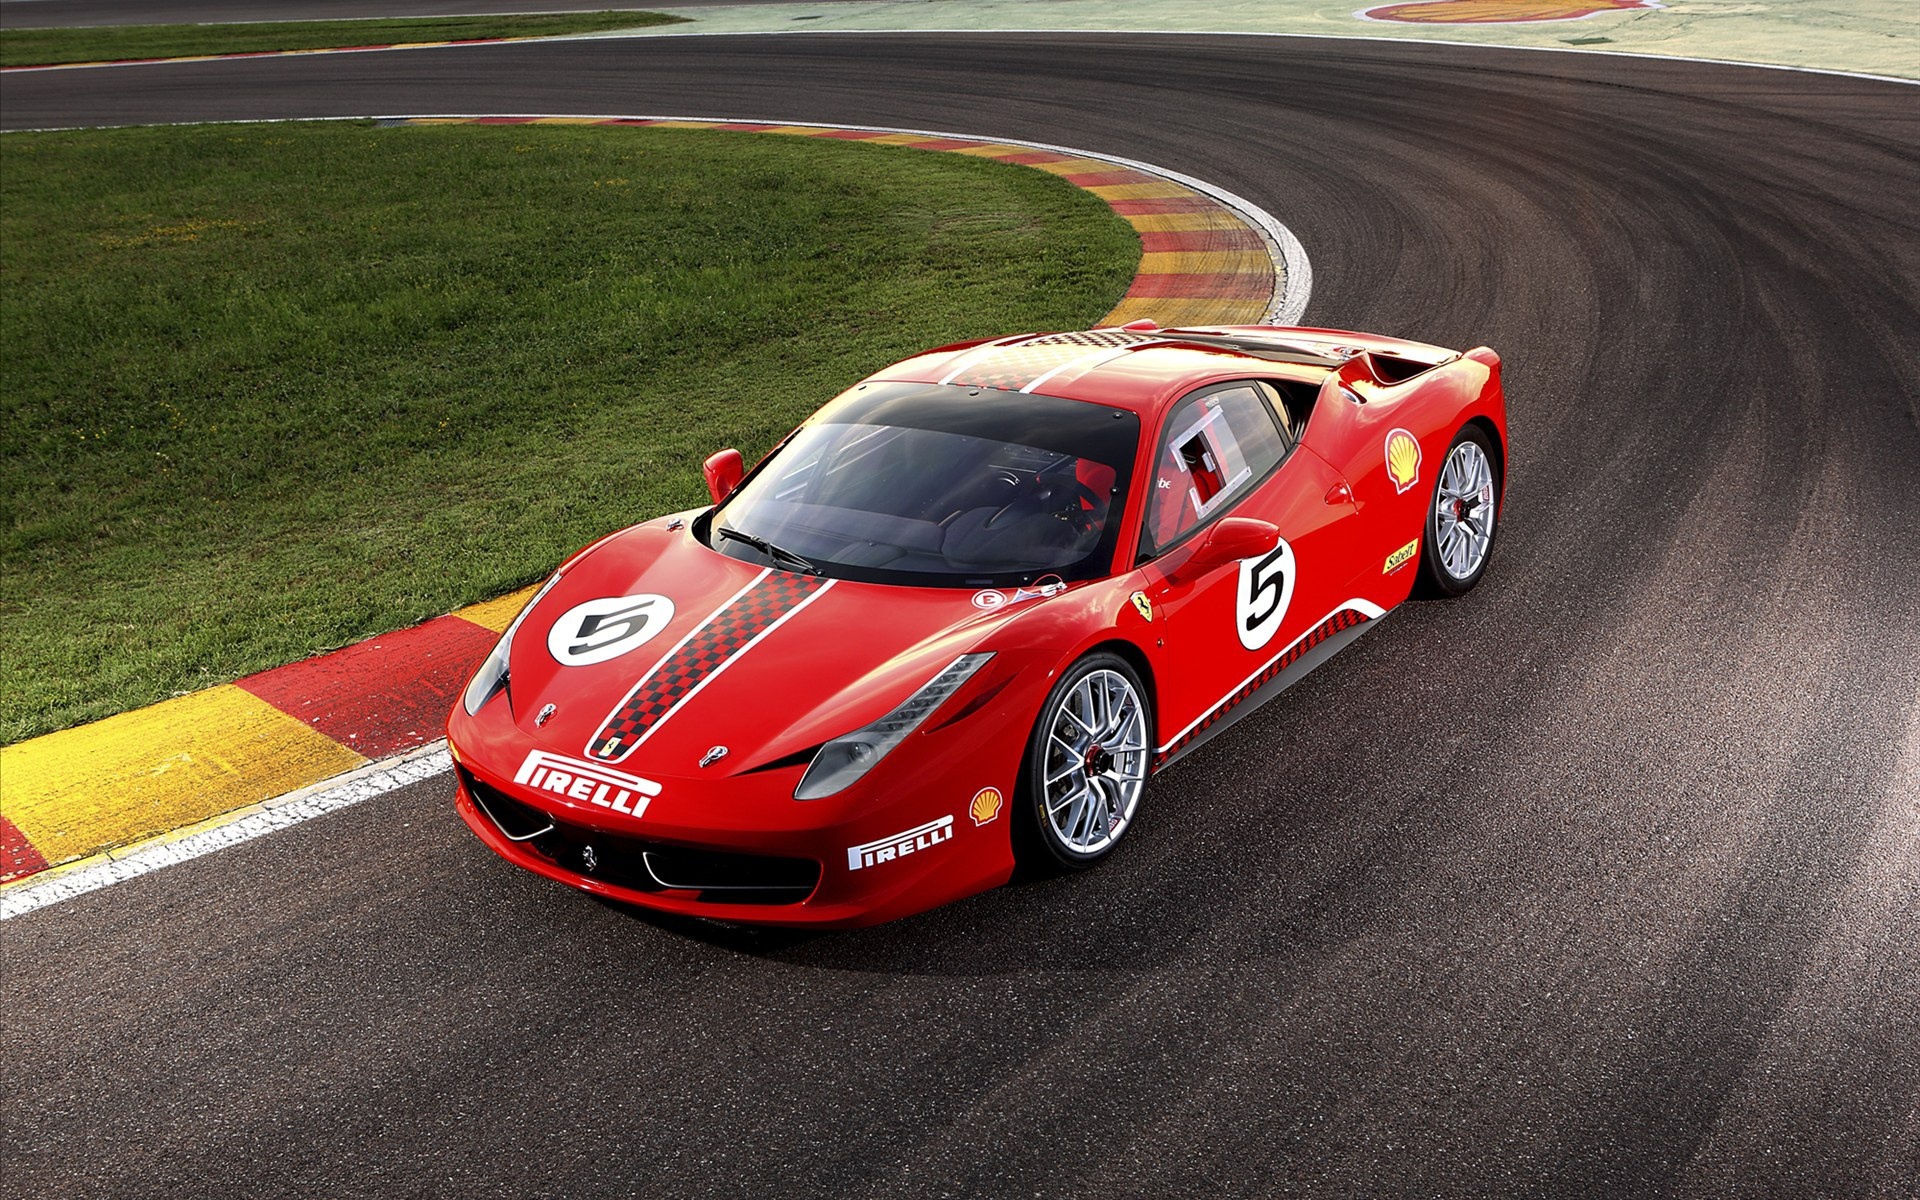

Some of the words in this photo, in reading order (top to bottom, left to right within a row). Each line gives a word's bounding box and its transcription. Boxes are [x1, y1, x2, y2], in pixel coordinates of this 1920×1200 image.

[1387, 543, 1414, 570] Sabelt
[982, 595, 996, 605] E
[1246, 545, 1284, 631] 5
[568, 600, 655, 655] 5
[513, 749, 662, 818] PIRELLI
[847, 814, 954, 870] PIRELLI
